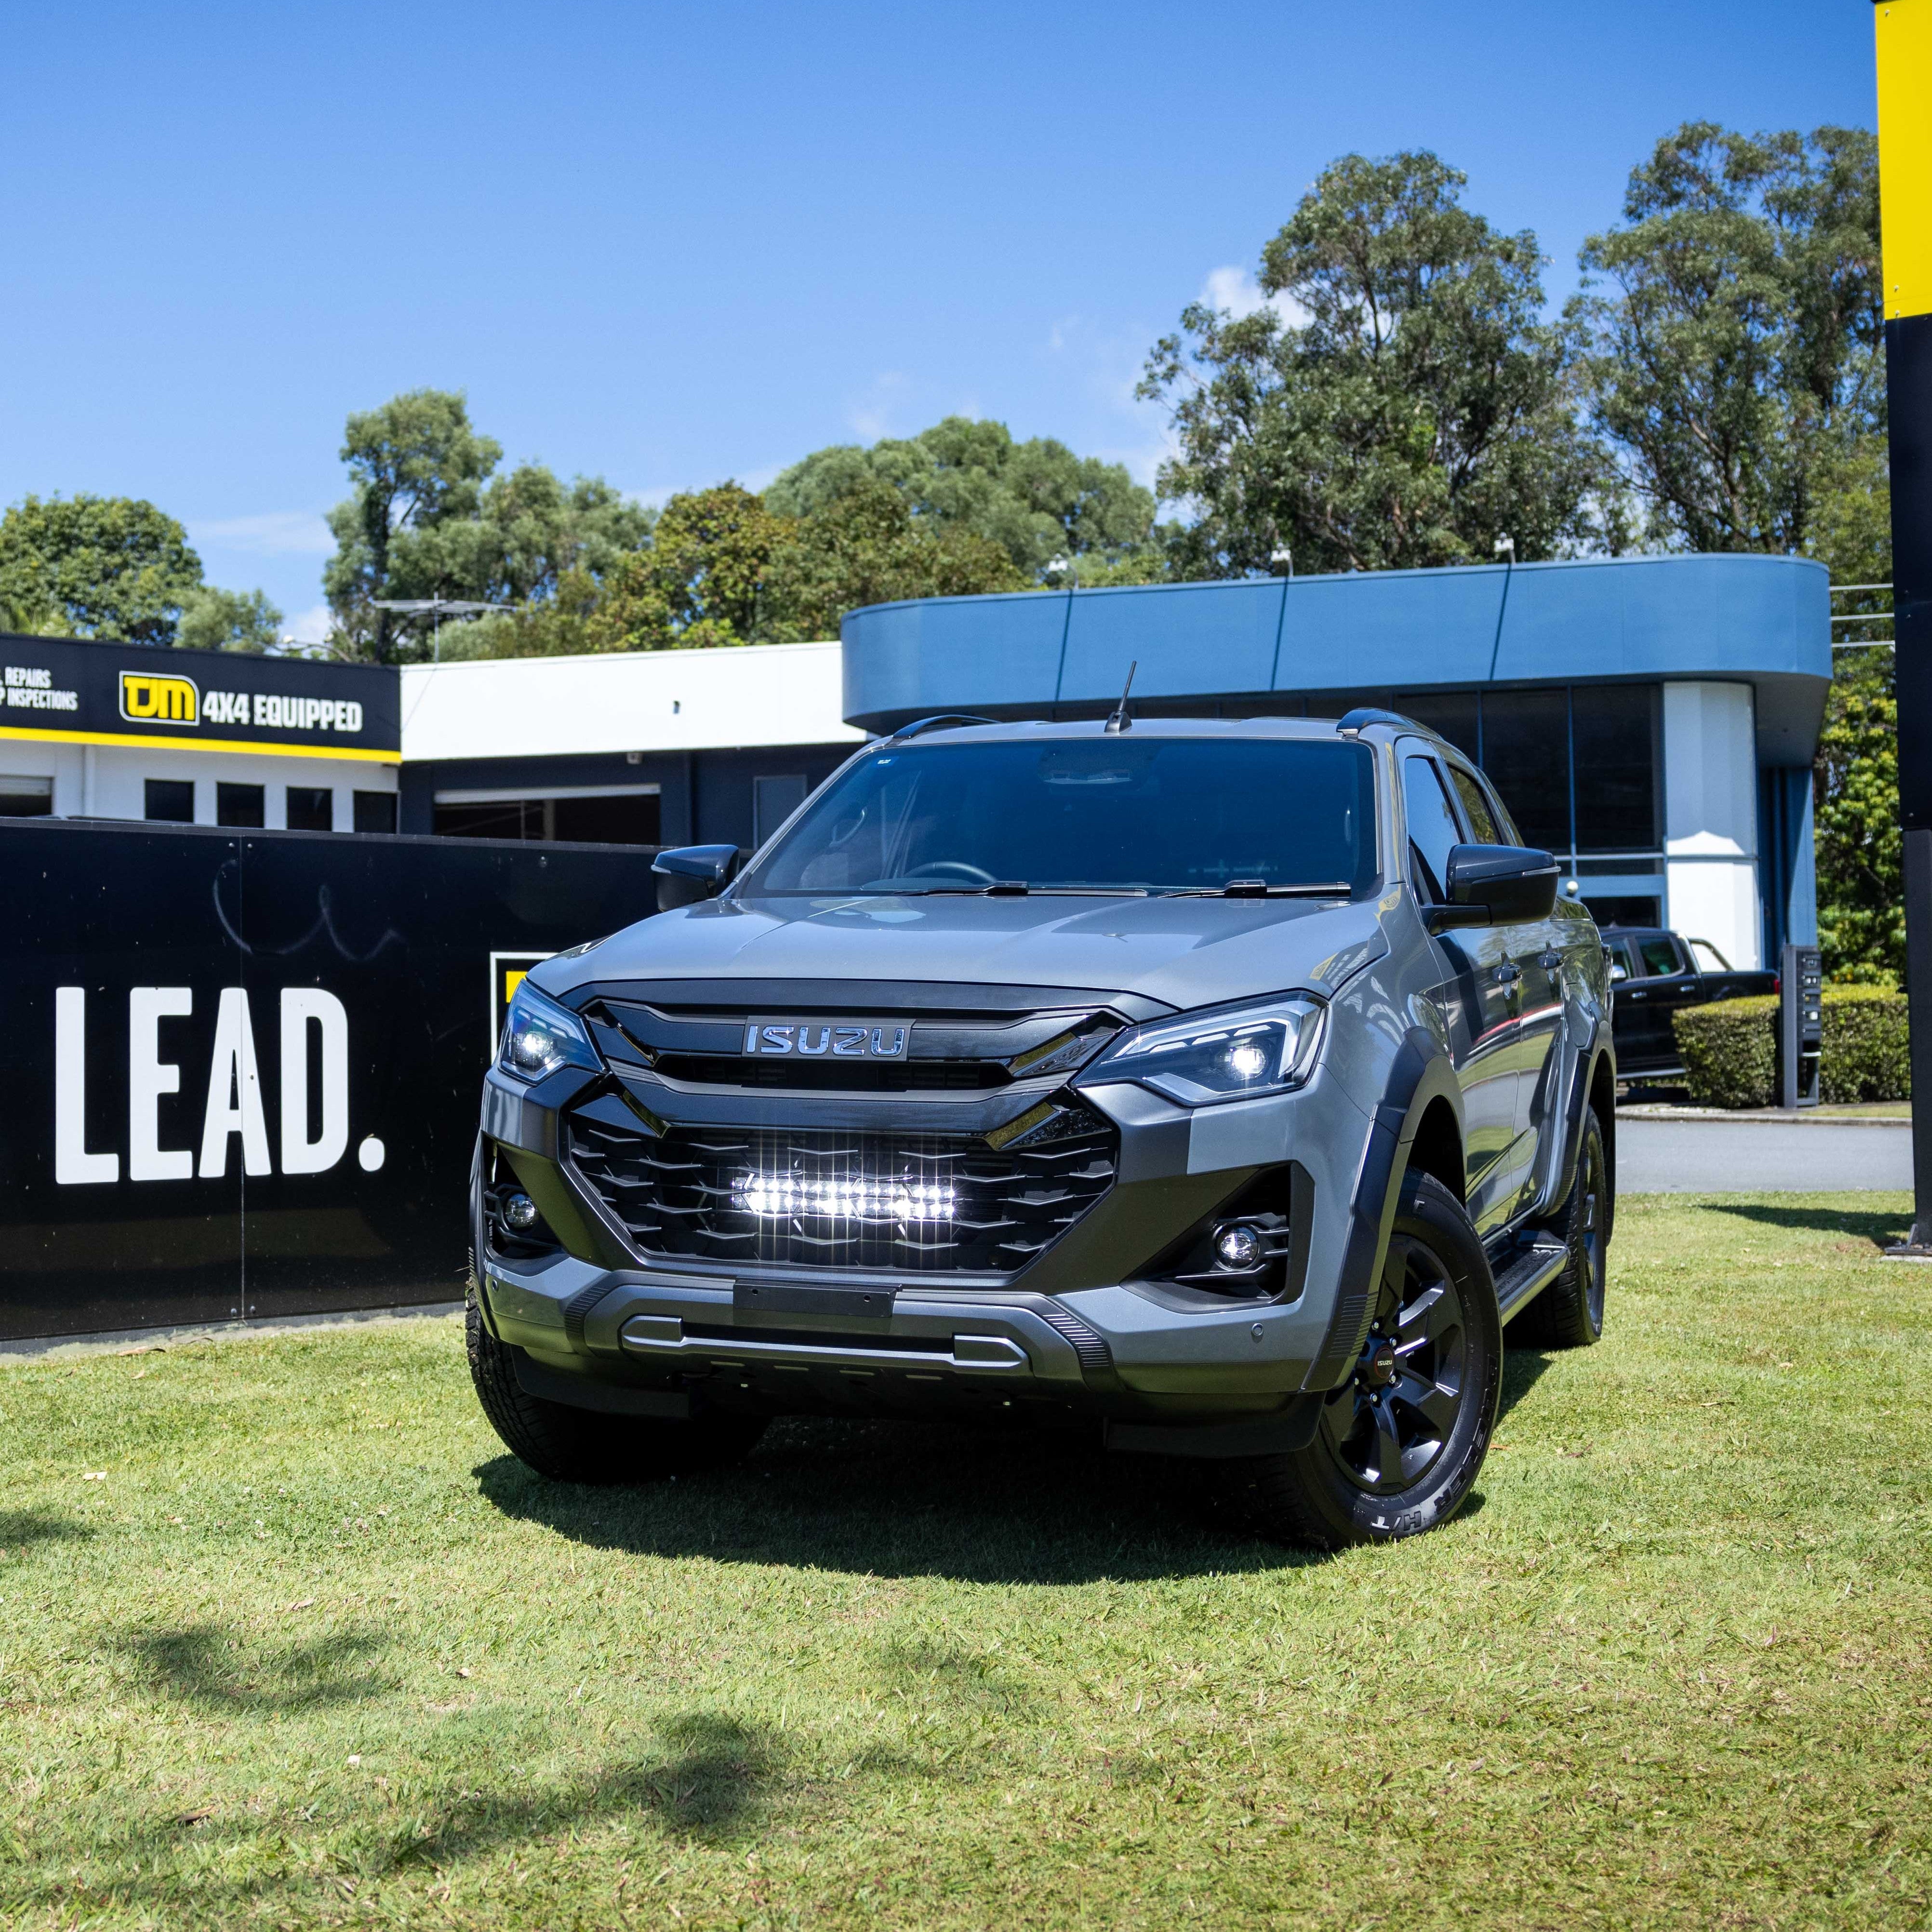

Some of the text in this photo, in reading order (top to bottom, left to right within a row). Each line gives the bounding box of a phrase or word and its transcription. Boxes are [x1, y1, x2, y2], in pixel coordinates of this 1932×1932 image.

[5, 666, 52, 688] REPAIRS
[7, 687, 78, 711] INSPECTIONS
[123, 676, 197, 721] TJM
[202, 691, 363, 732] 4X4 EQUIPPED
[746, 1025, 905, 1057] ISUZU
[55, 986, 386, 1184] LEAD.
